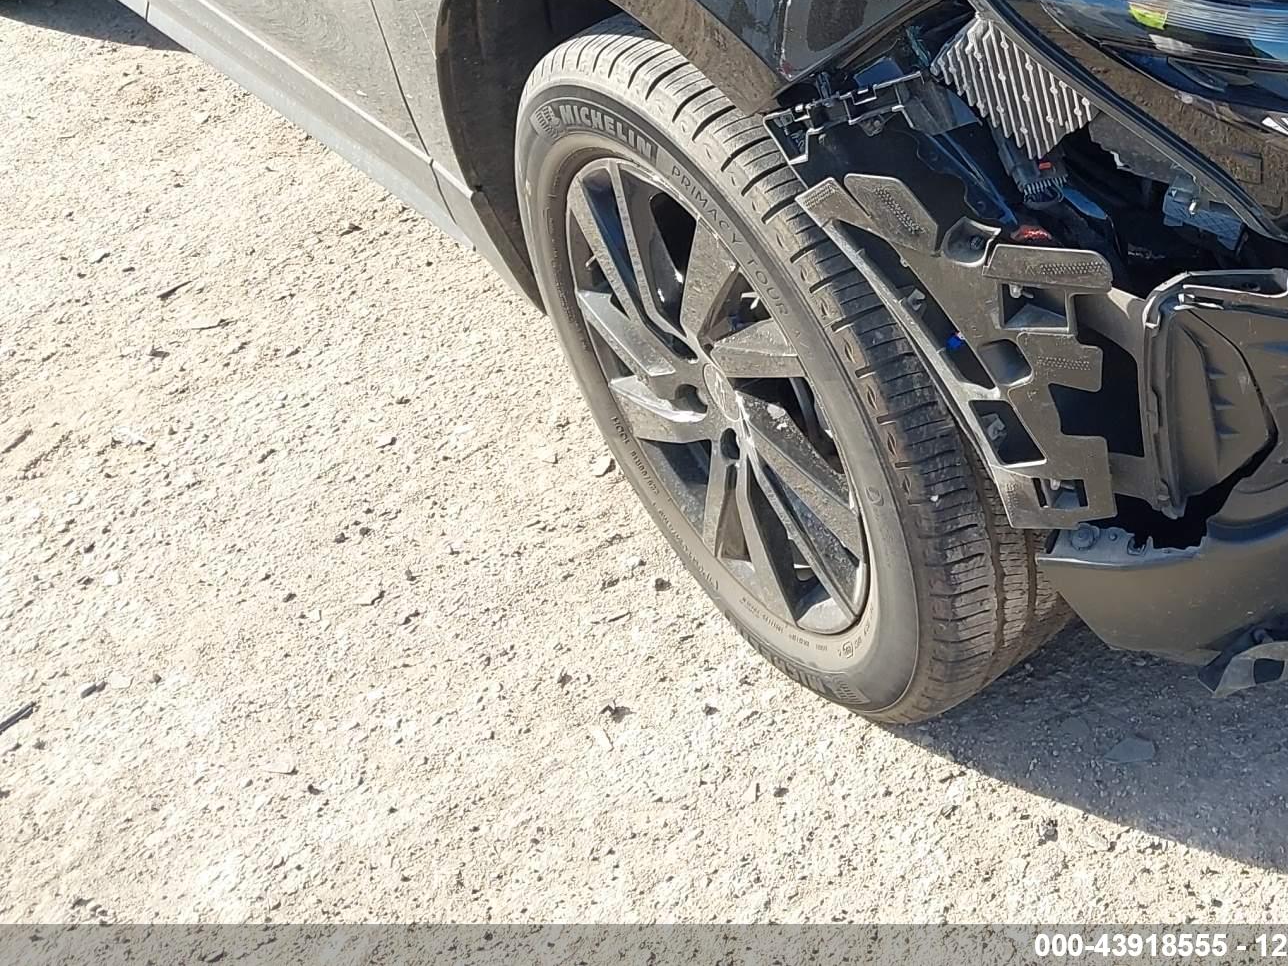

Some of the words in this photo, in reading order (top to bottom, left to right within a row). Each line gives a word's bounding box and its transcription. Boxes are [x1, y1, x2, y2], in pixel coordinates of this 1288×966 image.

[559, 105, 652, 158] MICHELIN
[671, 165, 743, 245] PRIMACY
[747, 259, 788, 315] TOUR
